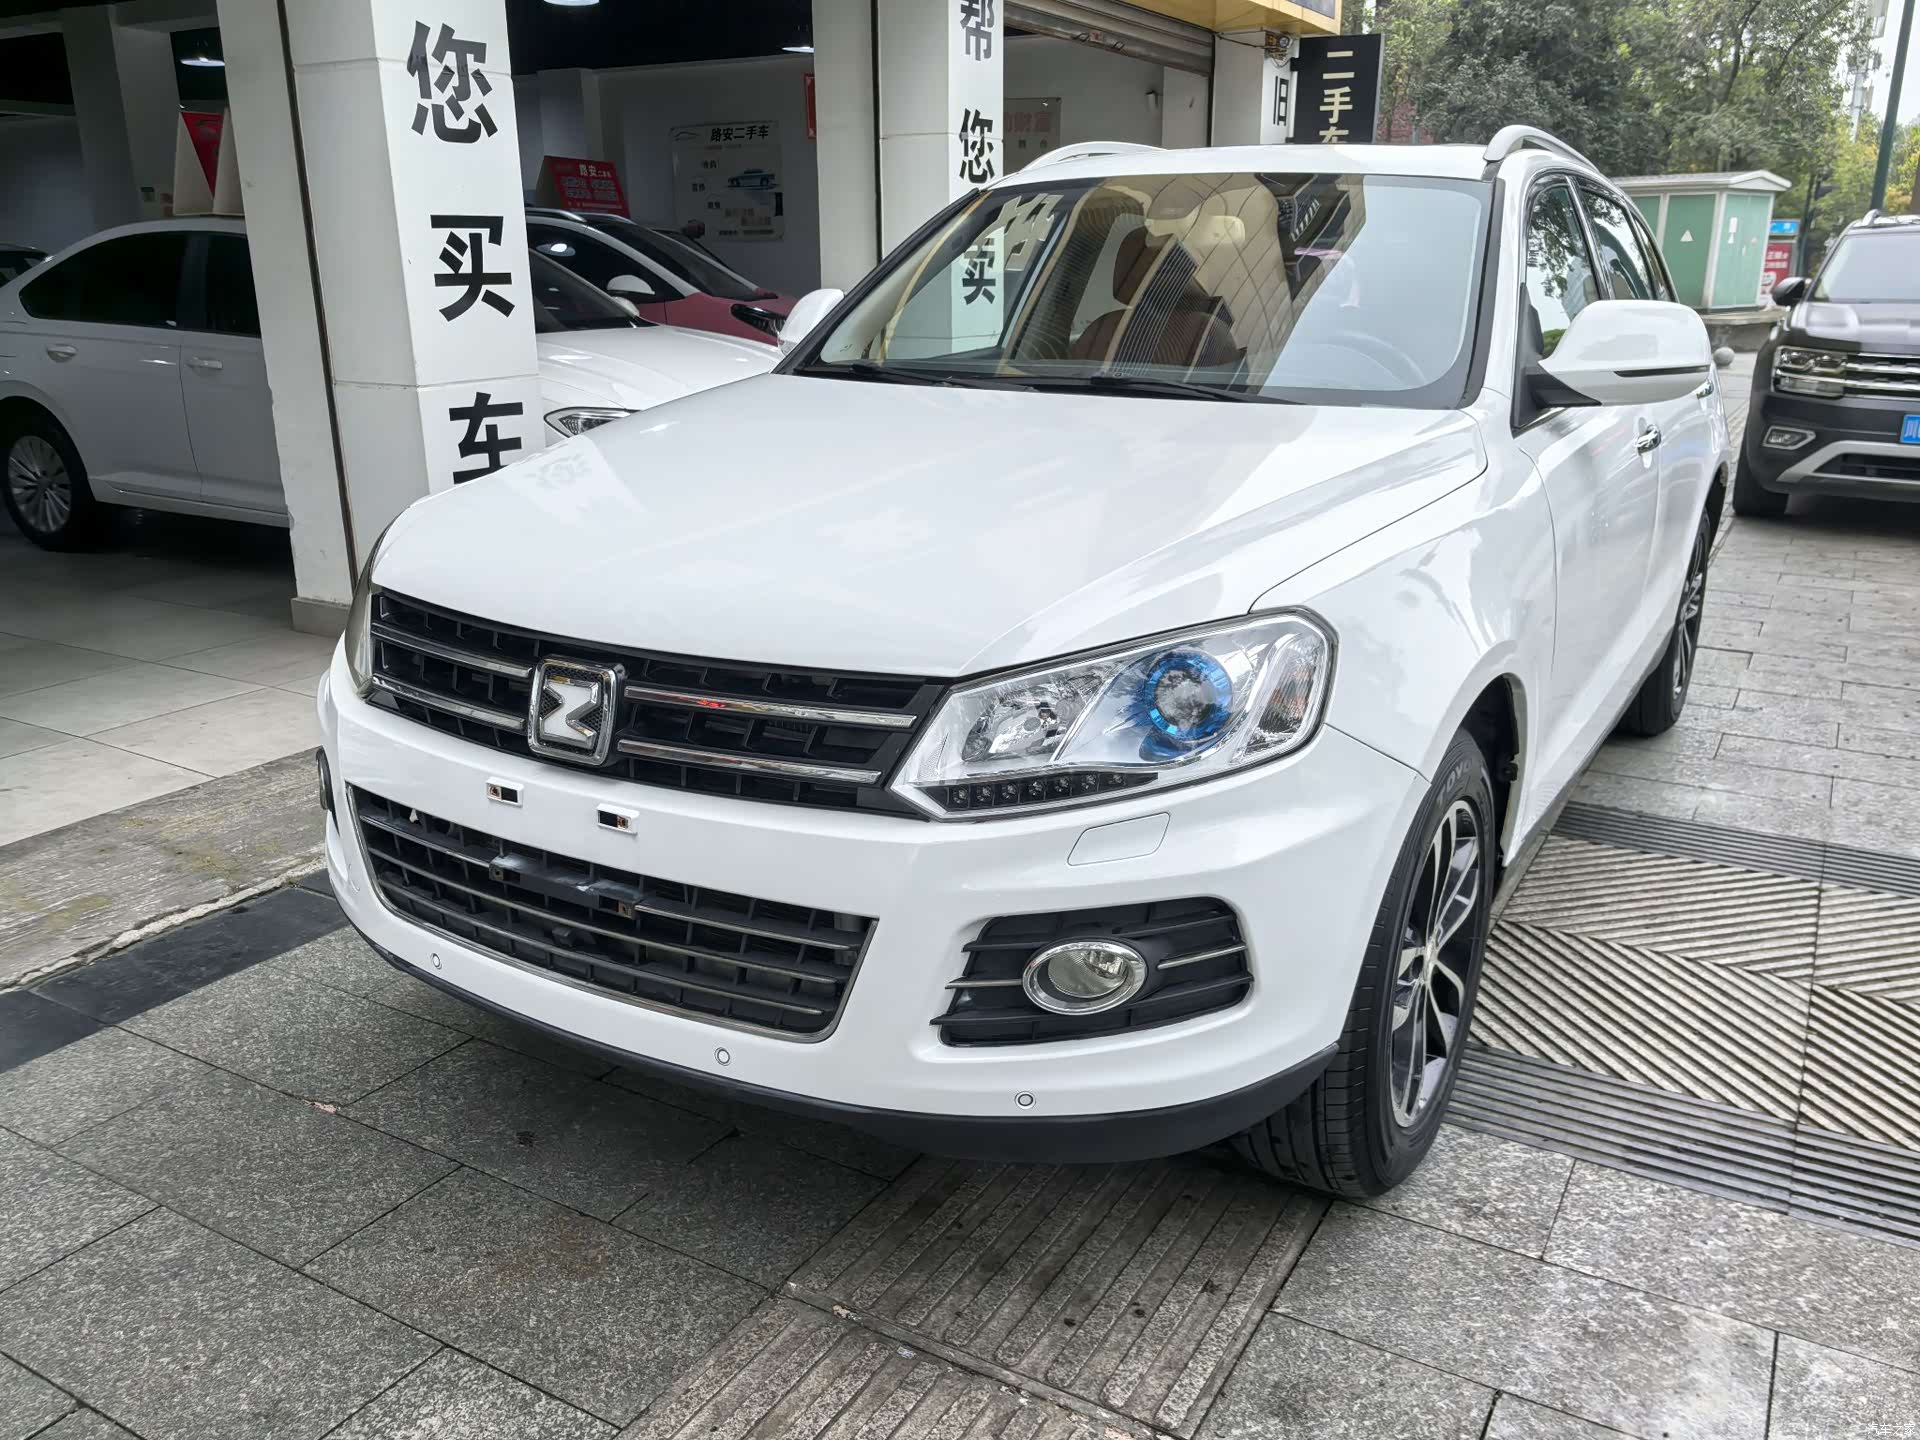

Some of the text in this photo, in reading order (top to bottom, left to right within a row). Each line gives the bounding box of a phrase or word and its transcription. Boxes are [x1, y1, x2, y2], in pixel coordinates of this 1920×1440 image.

[407, 20, 523, 485] 您买车
[710, 125, 769, 142] 路安二手车
